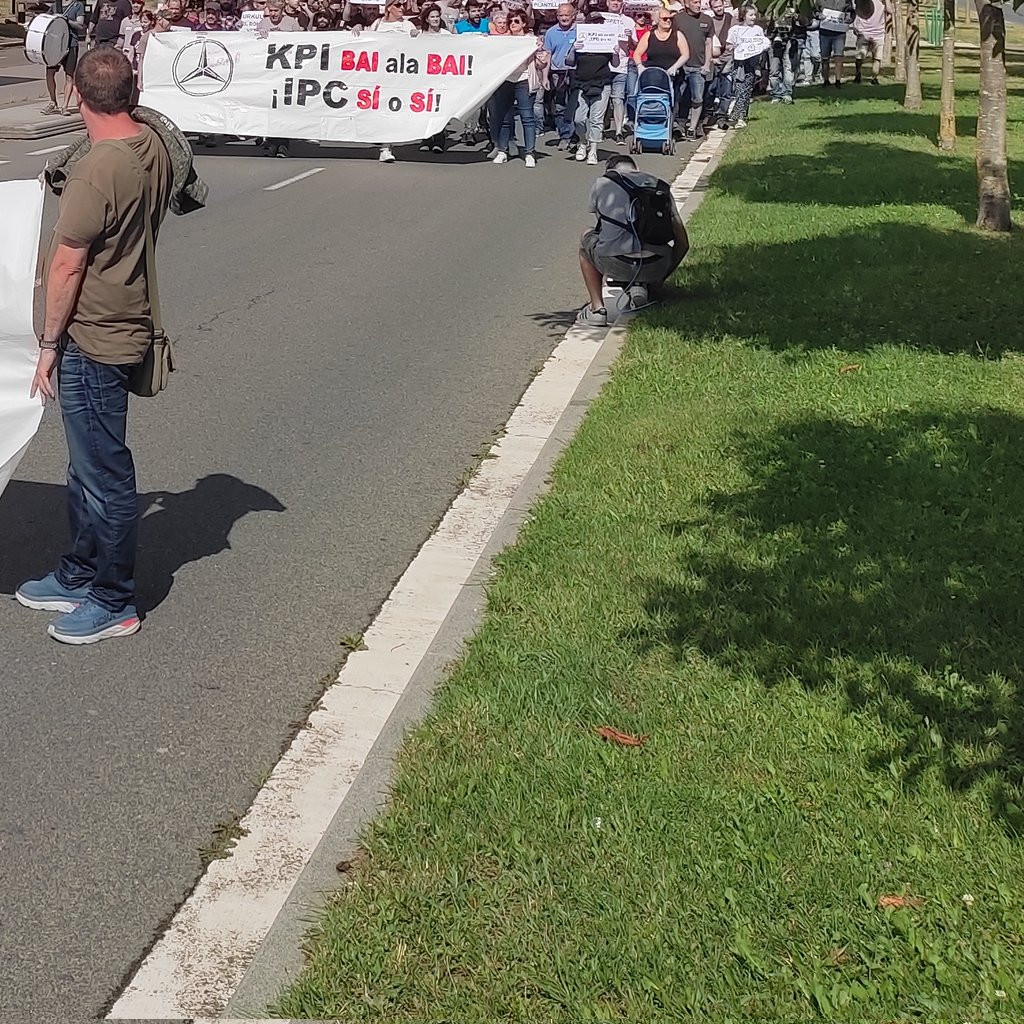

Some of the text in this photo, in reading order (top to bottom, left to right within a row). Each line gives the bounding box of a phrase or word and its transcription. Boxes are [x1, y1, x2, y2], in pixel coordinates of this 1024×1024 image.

[265, 43, 474, 76] KPI BAI ala BAI!
[356, 85, 381, 110] SÍ
[388, 96, 402, 112] o
[409, 88, 442, 113] SÍ!
